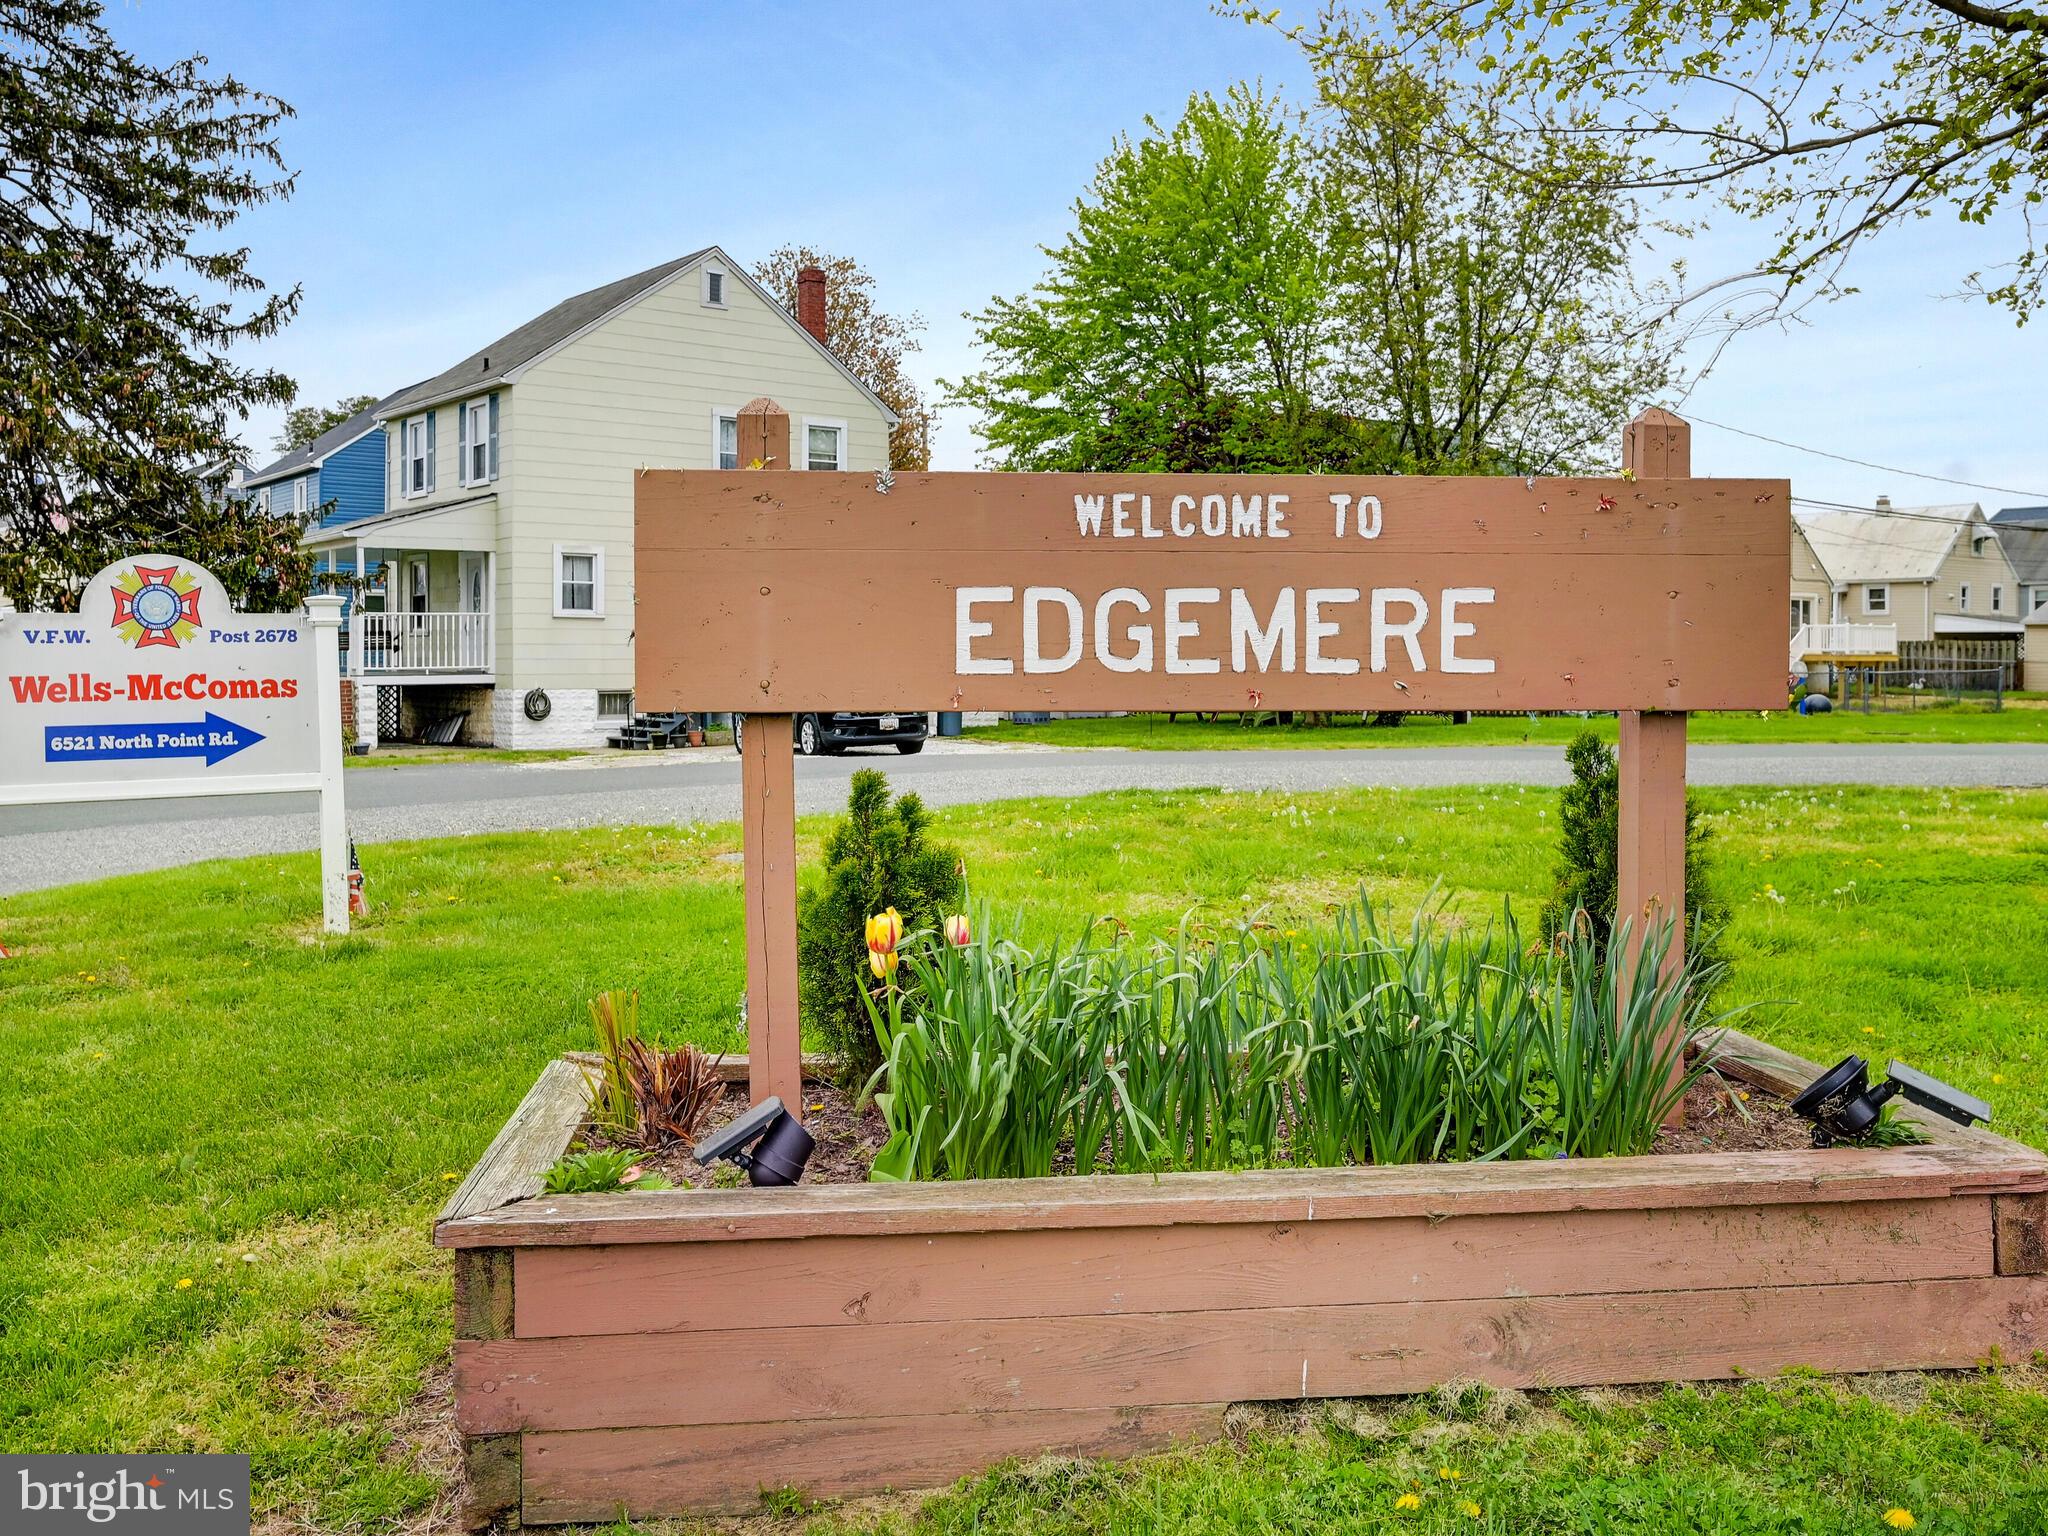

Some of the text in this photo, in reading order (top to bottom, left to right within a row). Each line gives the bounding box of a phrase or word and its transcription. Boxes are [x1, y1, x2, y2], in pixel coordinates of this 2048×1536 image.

[1074, 492, 1383, 540] WELCOME TO
[23, 629, 91, 645] V.F.W.
[209, 628, 298, 643] Post 2678
[954, 586, 1496, 675] EDGEMERE
[9, 673, 298, 704] Wells-McComas
[50, 730, 239, 751] 6521 North Point Rd.
